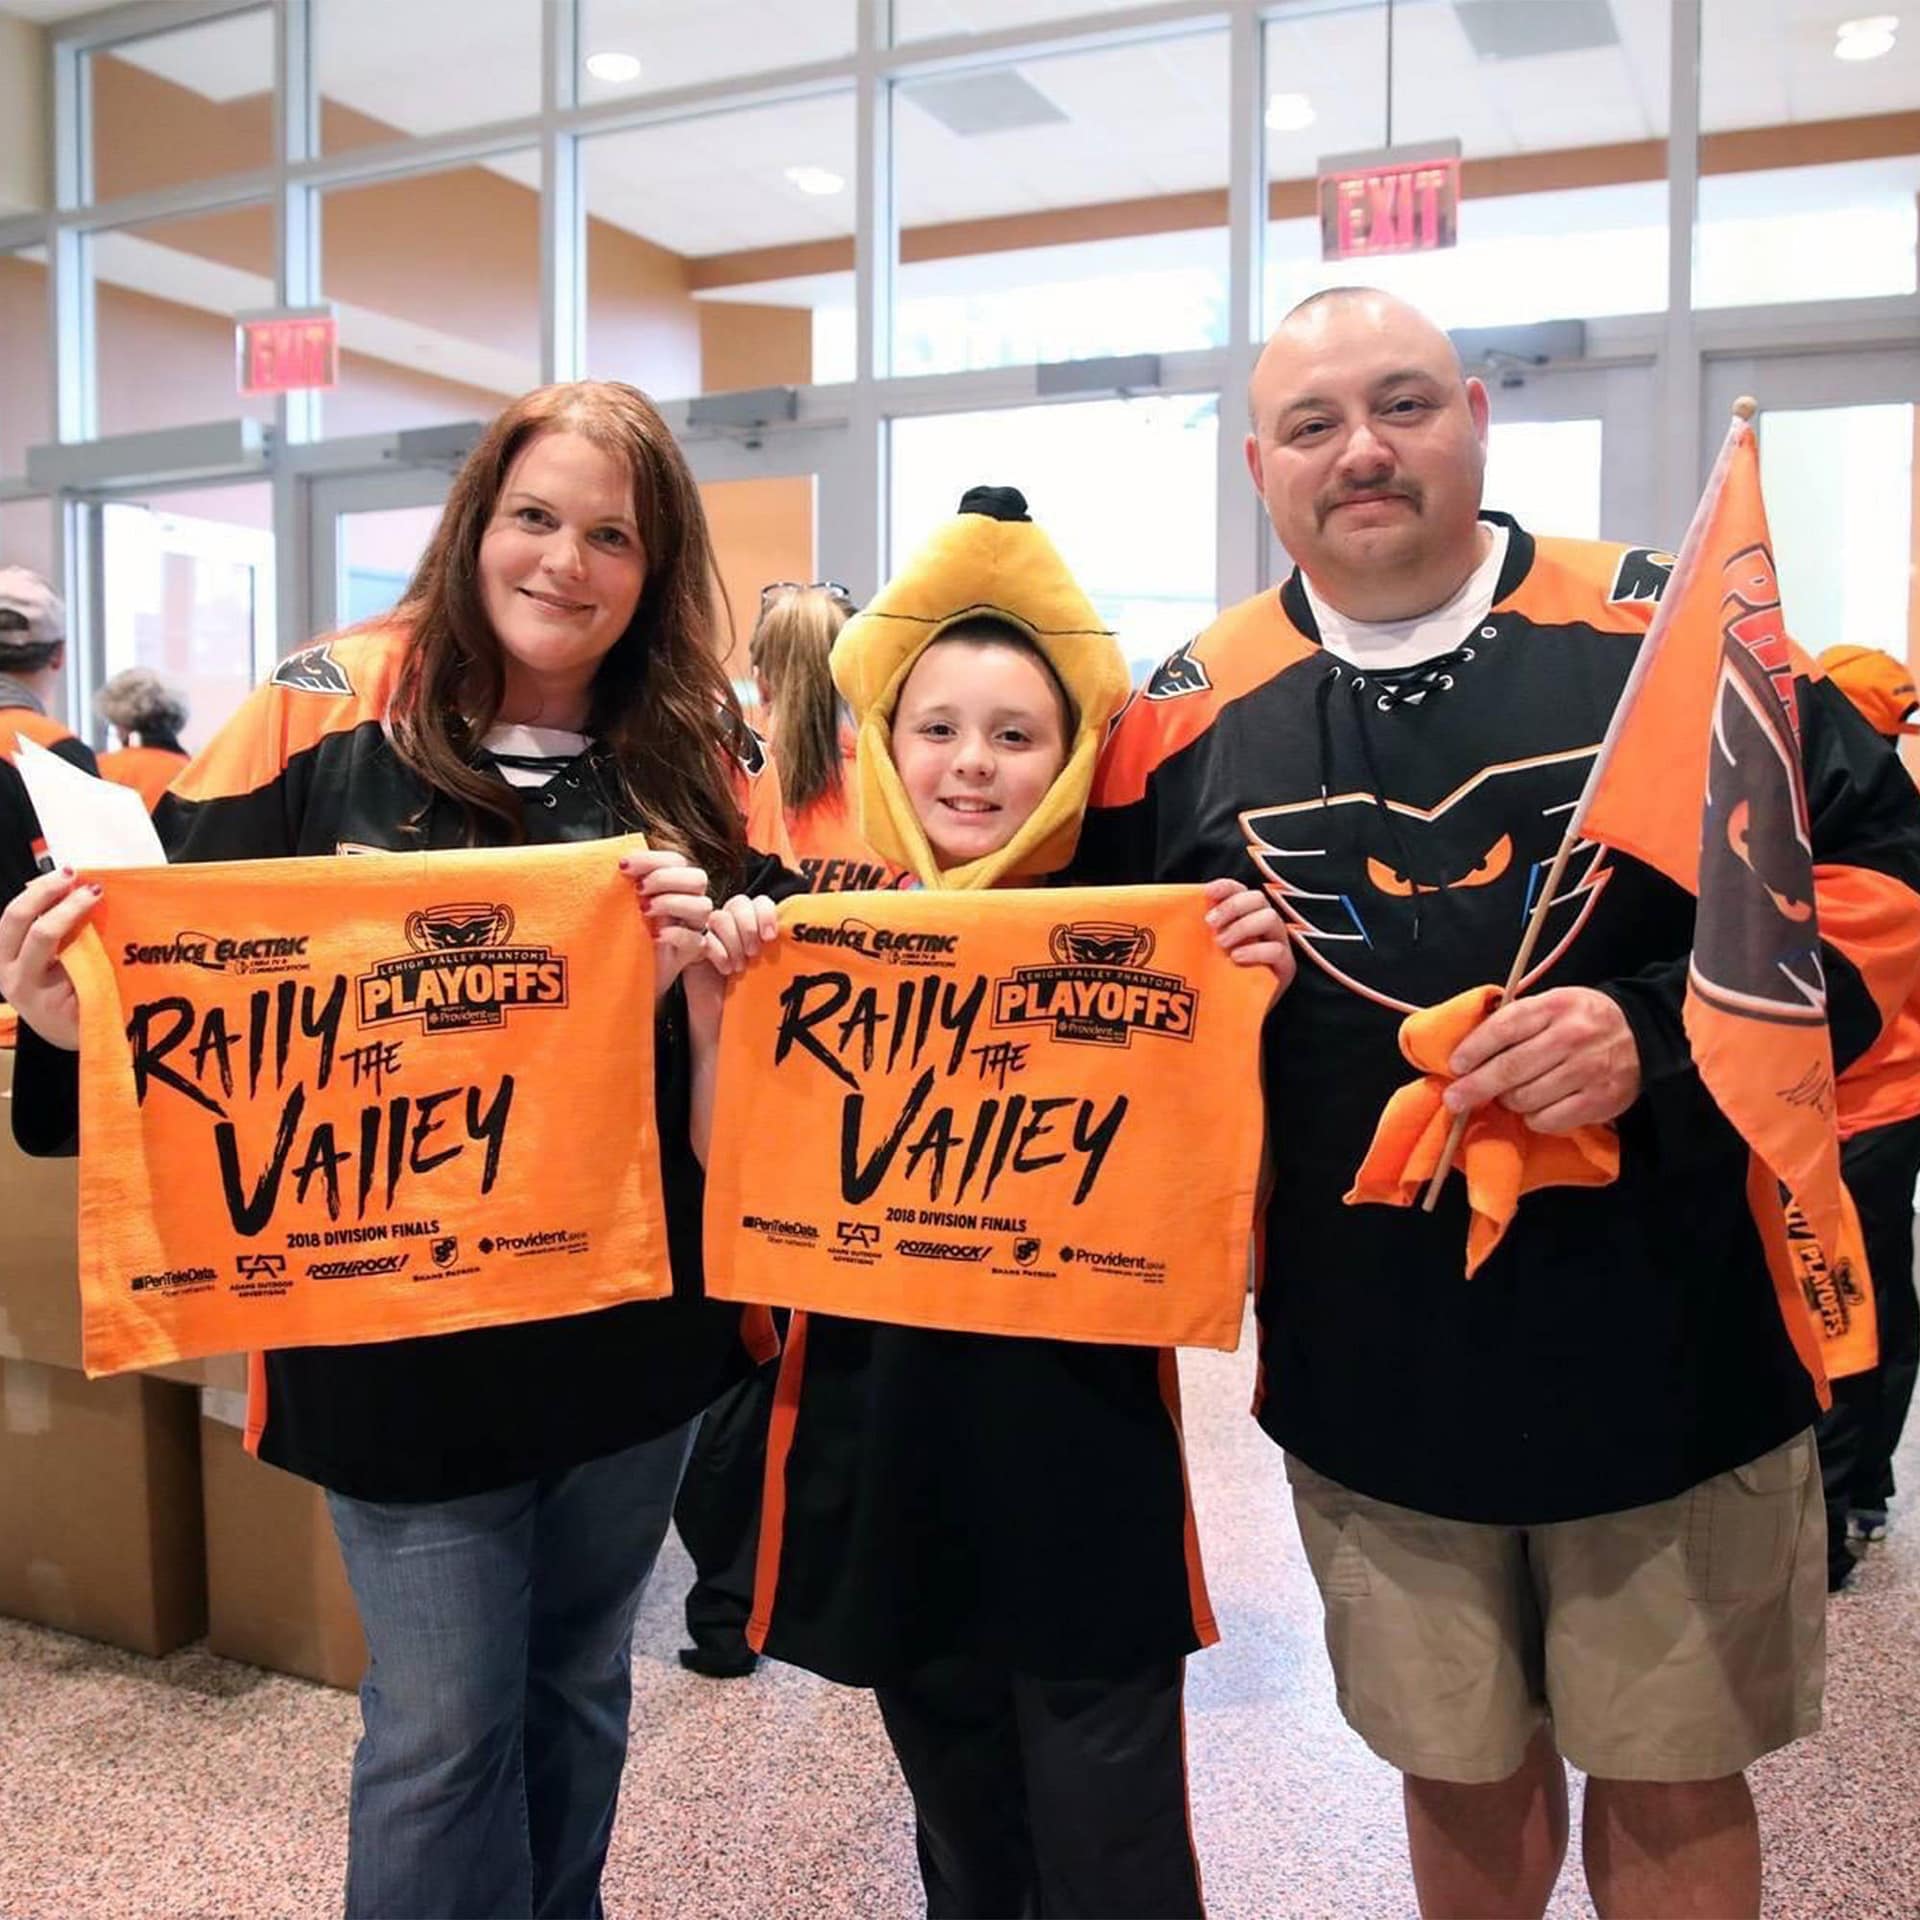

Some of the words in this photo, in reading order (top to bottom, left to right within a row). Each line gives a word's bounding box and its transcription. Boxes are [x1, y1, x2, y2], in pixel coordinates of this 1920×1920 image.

[1338, 170, 1446, 253] EXIT
[252, 325, 326, 387] EXIT
[380, 960, 424, 975] LEHIGH
[430, 953, 474, 966] VALLEY
[480, 951, 546, 961] PHANTOMS
[1020, 970, 1062, 982] LEHIGH
[1068, 969, 1111, 978] VALLEY
[1117, 971, 1179, 991] PHANTOMS
[363, 963, 561, 1021] PLAYOFFS
[999, 981, 1190, 1032] PLAYOFFS
[340, 1040, 404, 1096] THE
[971, 1043, 1029, 1089] THE
[287, 1233, 320, 1248] 2018
[324, 1226, 387, 1245] DIVISION
[392, 1220, 440, 1238] FINALS
[886, 1207, 916, 1223] 2018
[919, 1210, 977, 1230] DIVISION
[981, 1216, 1027, 1233] FINALS
[306, 1254, 410, 1279] ROTHROCK!
[895, 1239, 993, 1261] ROTHROCK!
